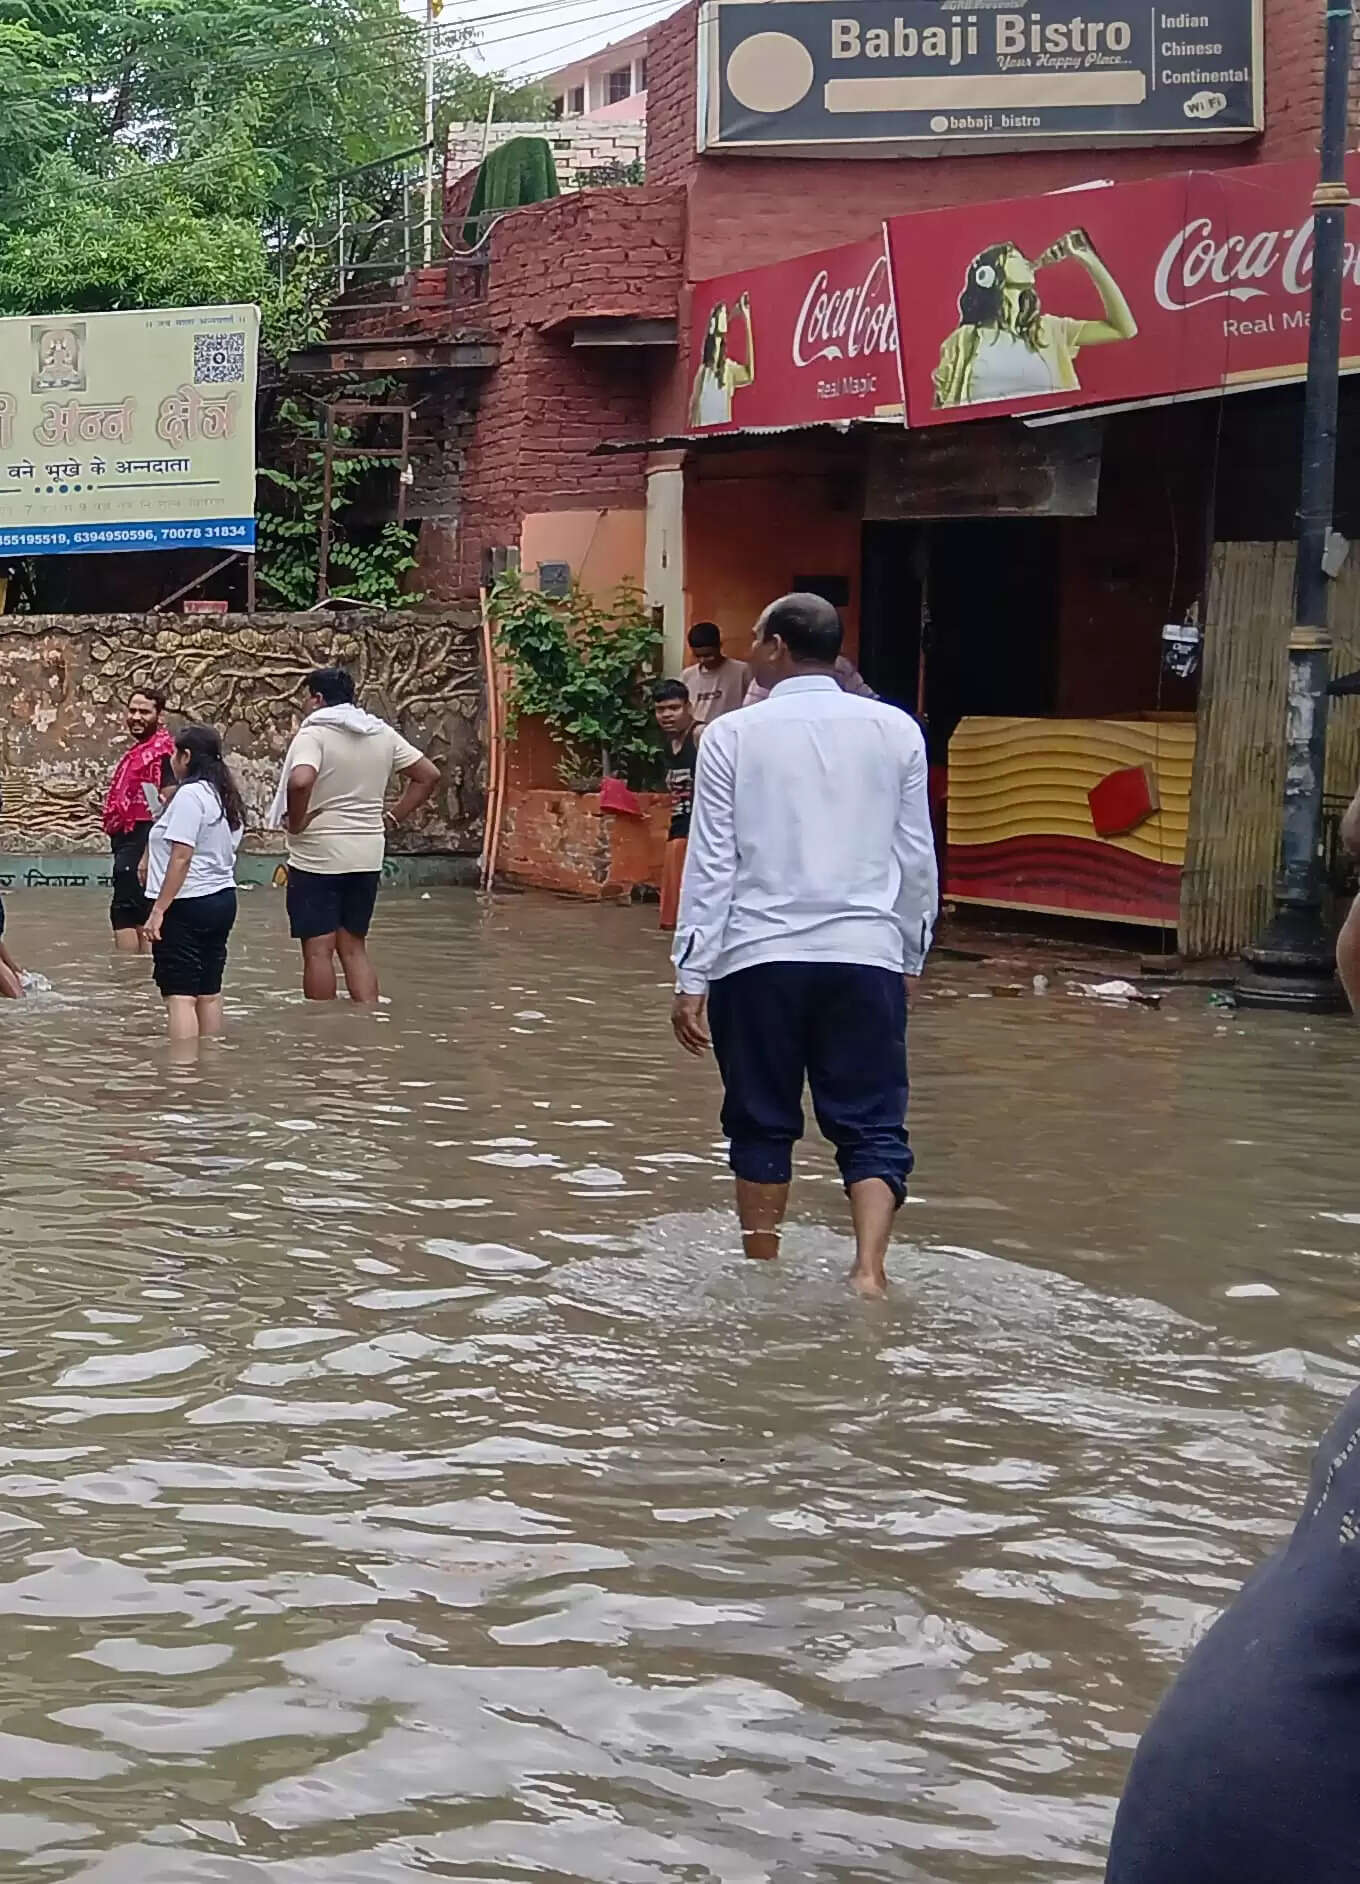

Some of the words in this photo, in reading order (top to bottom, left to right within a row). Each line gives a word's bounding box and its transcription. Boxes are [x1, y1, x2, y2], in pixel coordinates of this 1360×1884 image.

[1161, 13, 1209, 29] Indian
[831, 16, 977, 66] Babaji
[996, 14, 1131, 54] Bistro
[1161, 42, 1223, 56] Chinese
[1036, 53, 1082, 69] Happy
[1162, 68, 1249, 84] Continental
[950, 114, 1041, 131] babaji_bistro
[1223, 312, 1275, 337] Real
[34, 396, 137, 449] अन्न
[45, 456, 82, 482] भूखे
[90, 455, 106, 475] के
[115, 458, 190, 475] अन्नदाता
[161, 527, 202, 540] 70078
[204, 525, 246, 538] 31834
